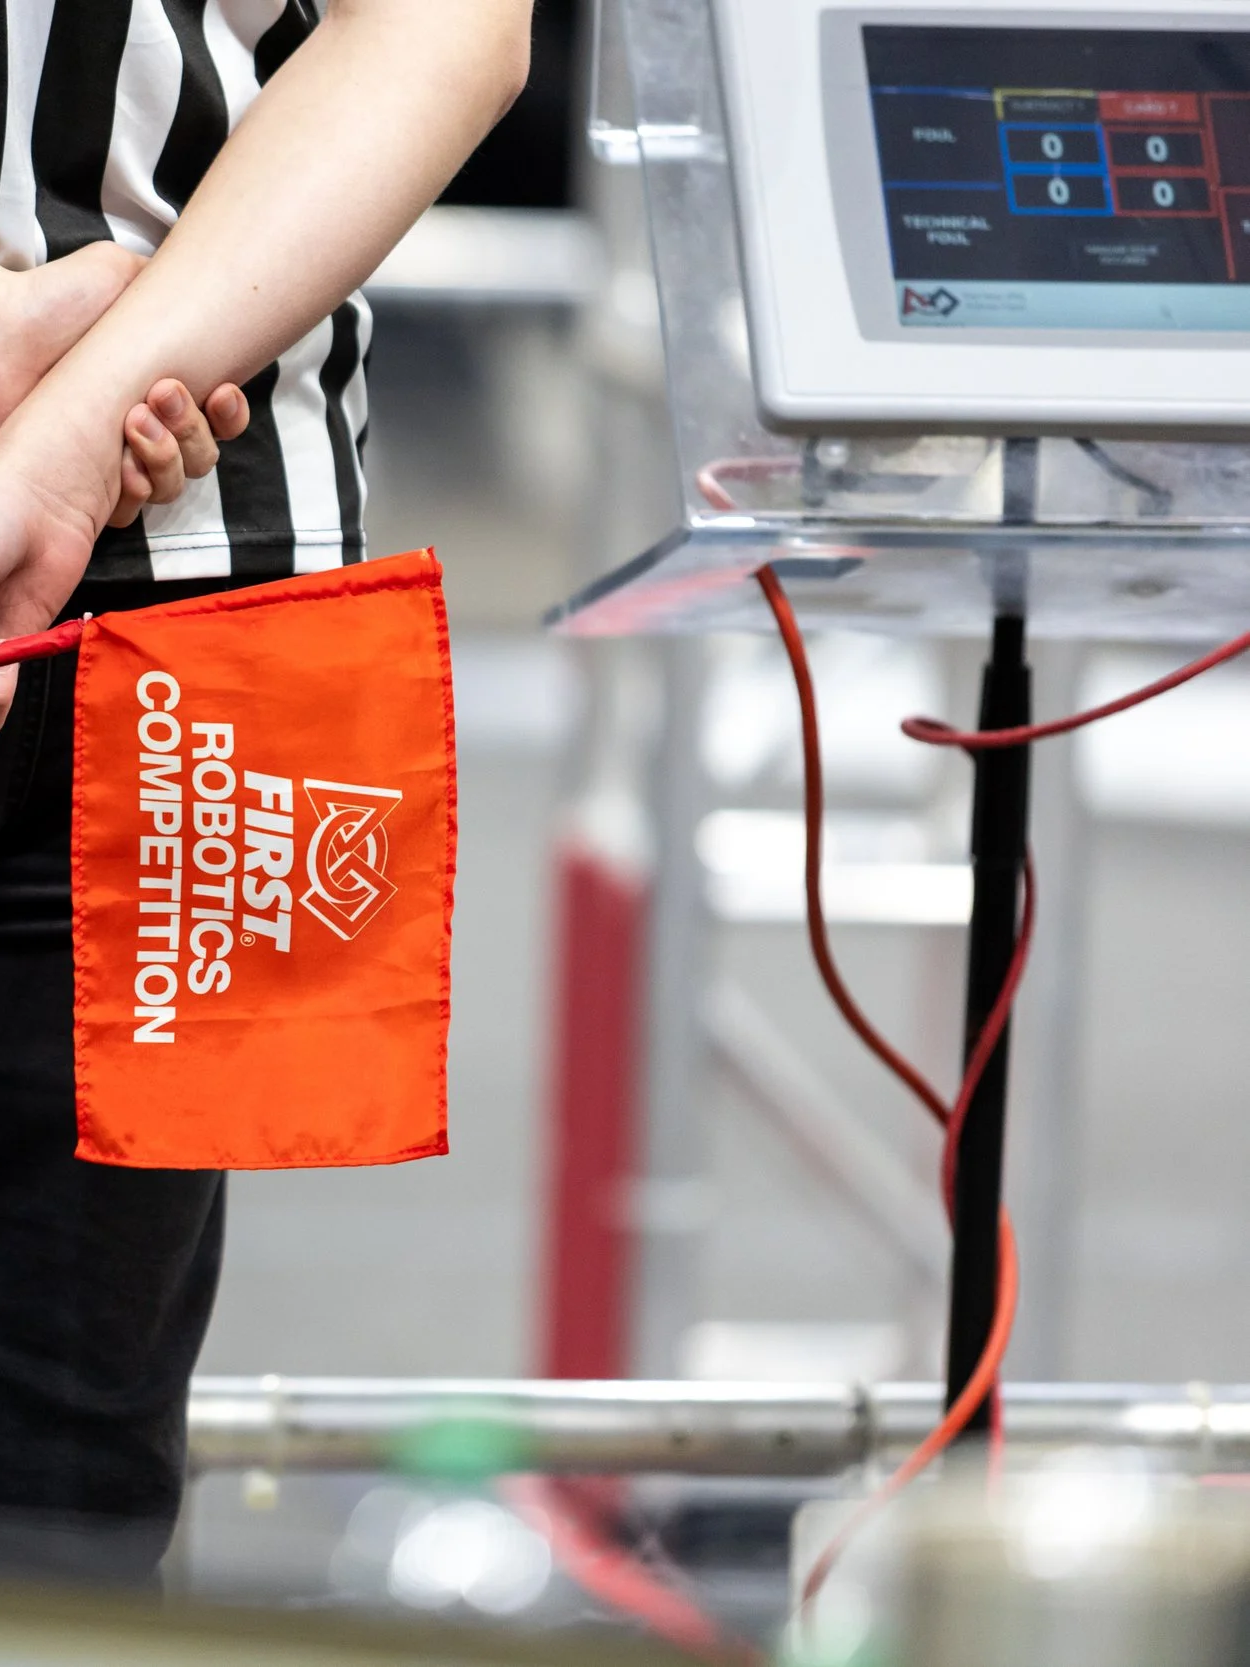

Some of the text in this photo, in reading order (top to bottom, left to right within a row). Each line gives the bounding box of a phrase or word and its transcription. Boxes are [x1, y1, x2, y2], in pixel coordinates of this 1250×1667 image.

[1041, 132, 1064, 160] 0
[1145, 135, 1169, 163] 0
[1047, 177, 1070, 205] 0
[1152, 180, 1175, 207] 0
[133, 670, 183, 1044] COMPETITION
[187, 722, 237, 995] ROBOTICS
